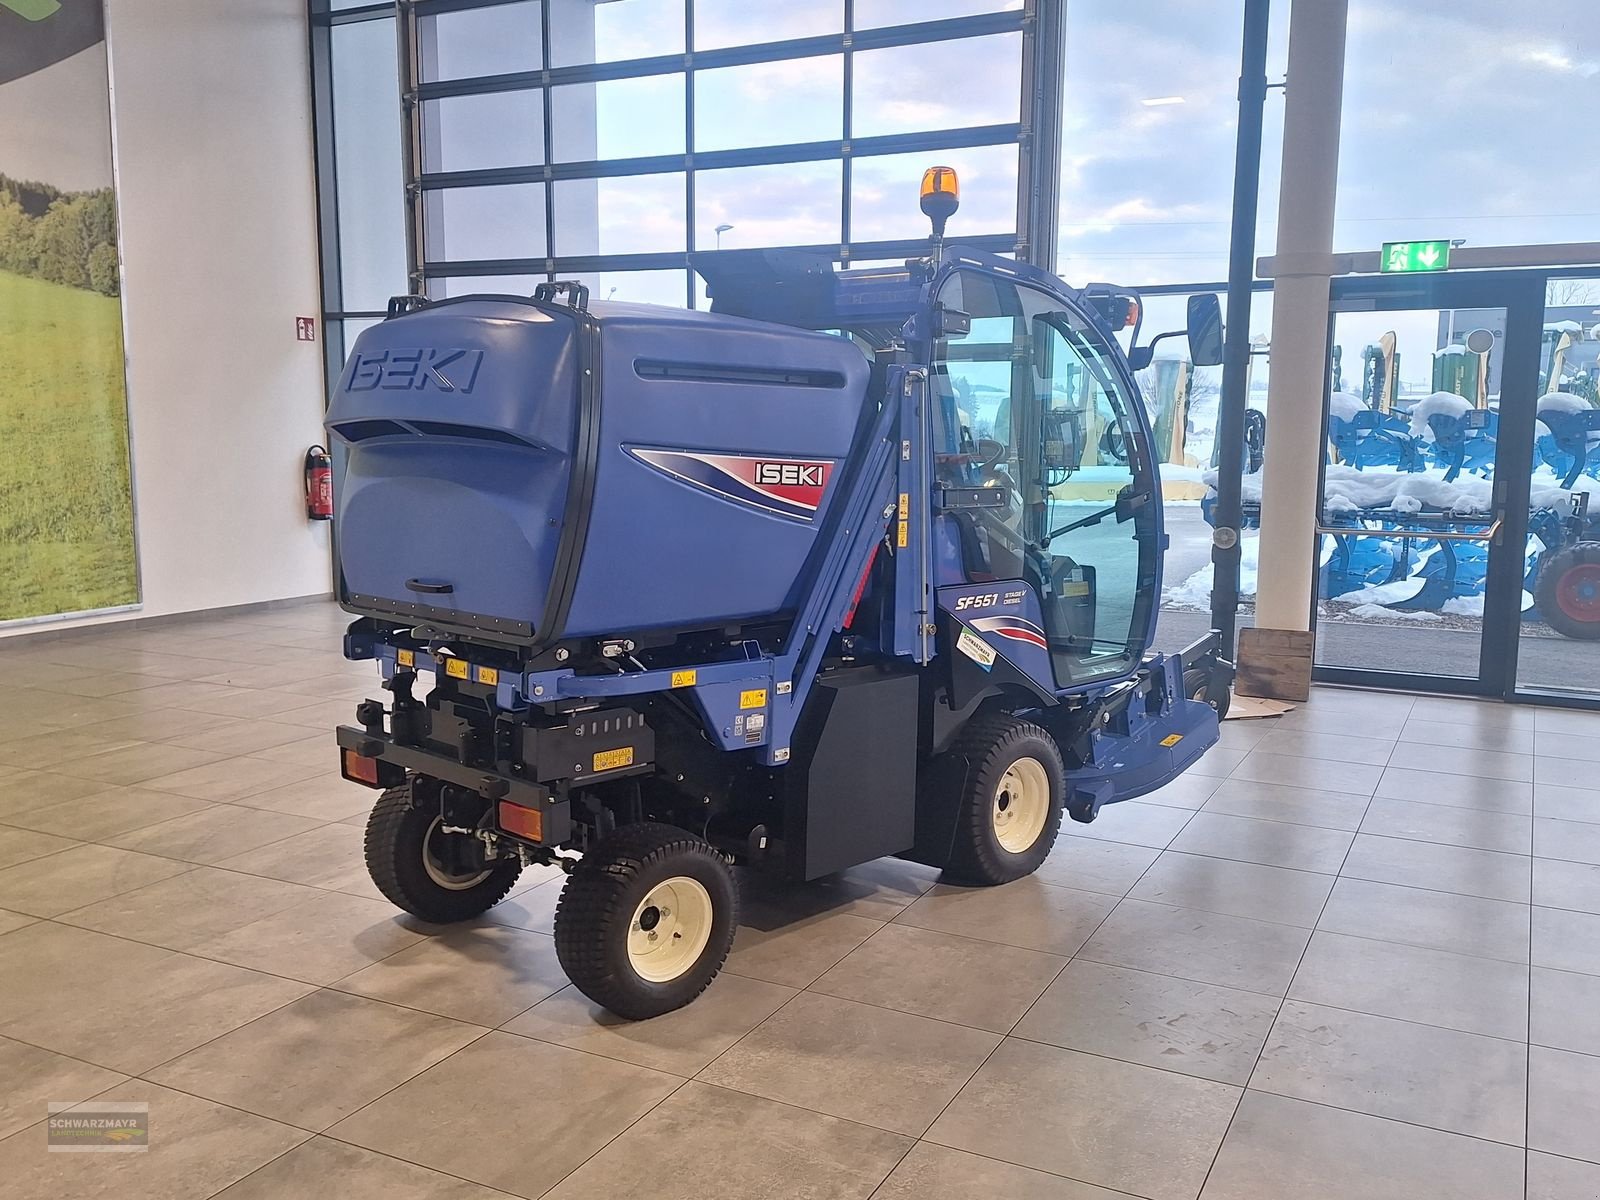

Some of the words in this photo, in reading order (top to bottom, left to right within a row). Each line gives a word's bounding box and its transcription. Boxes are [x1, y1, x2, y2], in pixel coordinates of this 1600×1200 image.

[344, 347, 485, 394] ISEKI
[754, 462, 824, 487] ISEKI
[955, 593, 999, 611] SF551
